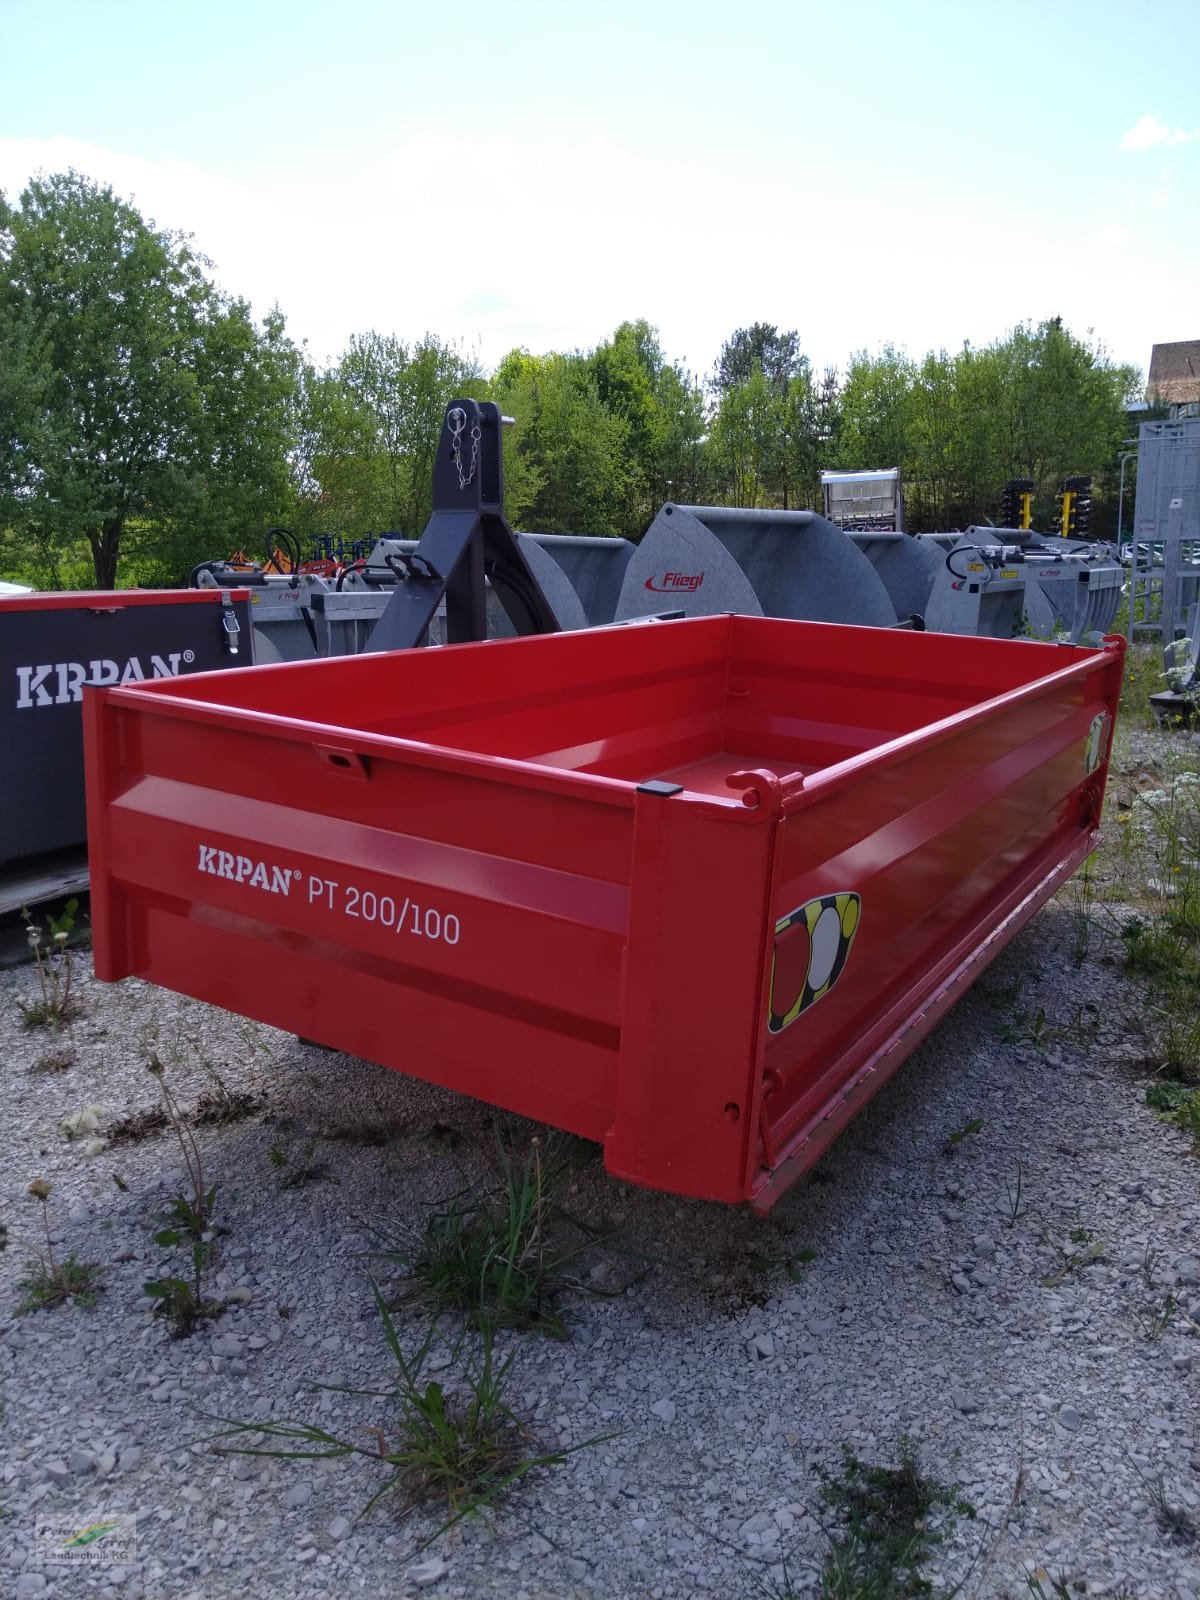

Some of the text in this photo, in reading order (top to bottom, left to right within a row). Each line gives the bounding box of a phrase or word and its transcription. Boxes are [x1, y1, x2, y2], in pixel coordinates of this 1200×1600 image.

[662, 571, 705, 590] Fliegl
[309, 876, 338, 909] PT
[345, 887, 460, 945] 200/100
